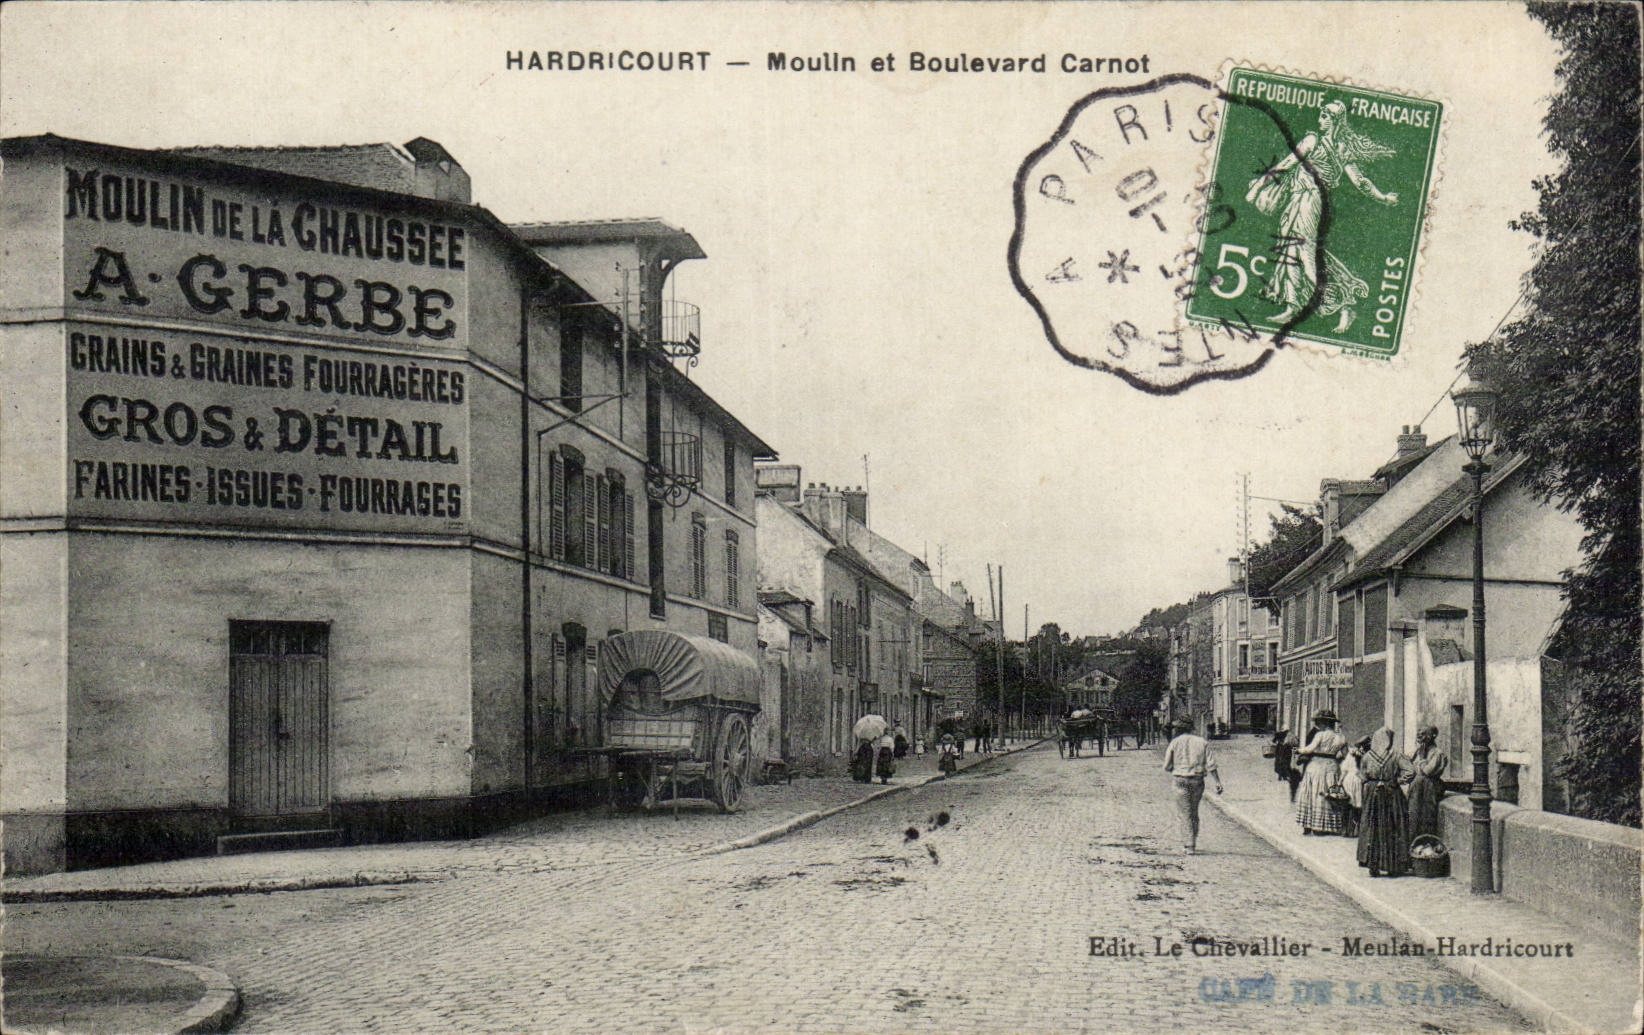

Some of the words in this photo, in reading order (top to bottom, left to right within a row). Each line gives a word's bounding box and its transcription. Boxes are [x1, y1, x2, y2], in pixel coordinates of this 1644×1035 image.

[1236, 77, 1325, 109] REPUBLIQUE
[1350, 97, 1432, 129] FRANÇAISE
[64, 166, 205, 236] MOULIN
[211, 198, 245, 241] DE
[176, 251, 457, 341] GERBE
[1372, 256, 1405, 339] POSTES
[69, 332, 166, 377] GRAINS
[170, 353, 187, 380] &
[190, 342, 293, 390] GRAINES
[303, 354, 466, 405] FOURRAGÈRES
[78, 393, 236, 448] GROS
[243, 416, 265, 452] &
[272, 405, 461, 465] DÉTAIL
[319, 473, 463, 519] FOURRAGES
